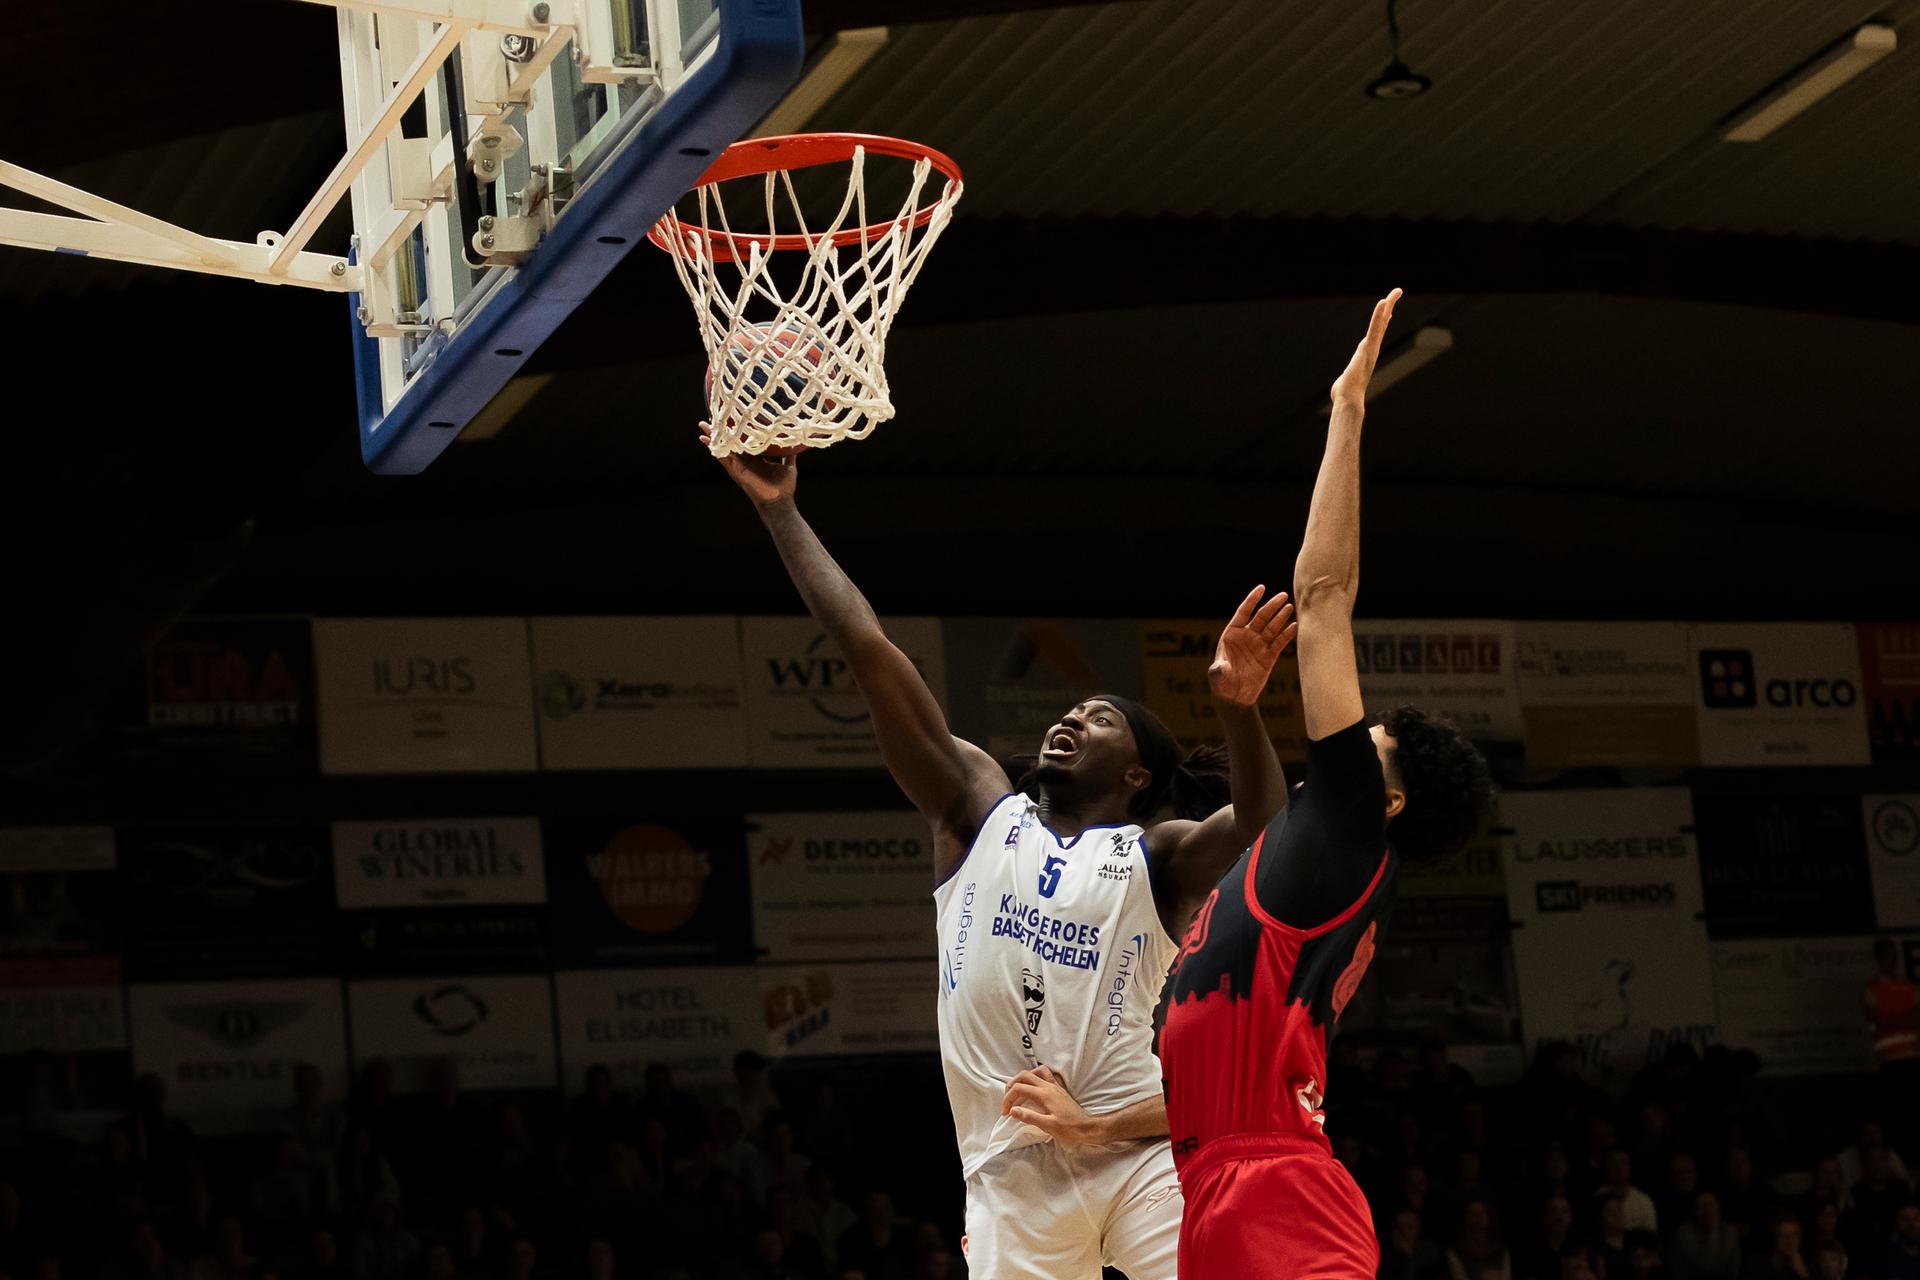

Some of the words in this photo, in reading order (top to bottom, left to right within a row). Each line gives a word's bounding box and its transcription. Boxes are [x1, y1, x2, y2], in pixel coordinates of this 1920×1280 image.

[374, 657, 475, 692] IURIS
[1766, 679, 1855, 706] arco
[373, 828, 497, 852] GLOBAL
[804, 840, 920, 861] DEMOCO
[1514, 837, 1686, 862] LAUWERS
[357, 852, 523, 879] WINERIES
[1038, 854, 1067, 899] 5
[1098, 863, 1133, 874] ALLAN
[607, 880, 696, 906] IMMO
[954, 882, 976, 971] Integras
[616, 988, 703, 1010] HOTEL
[1108, 949, 1135, 1036] Integras
[586, 1016, 732, 1042] ELISABETH
[177, 1059, 293, 1081] BENTLE
